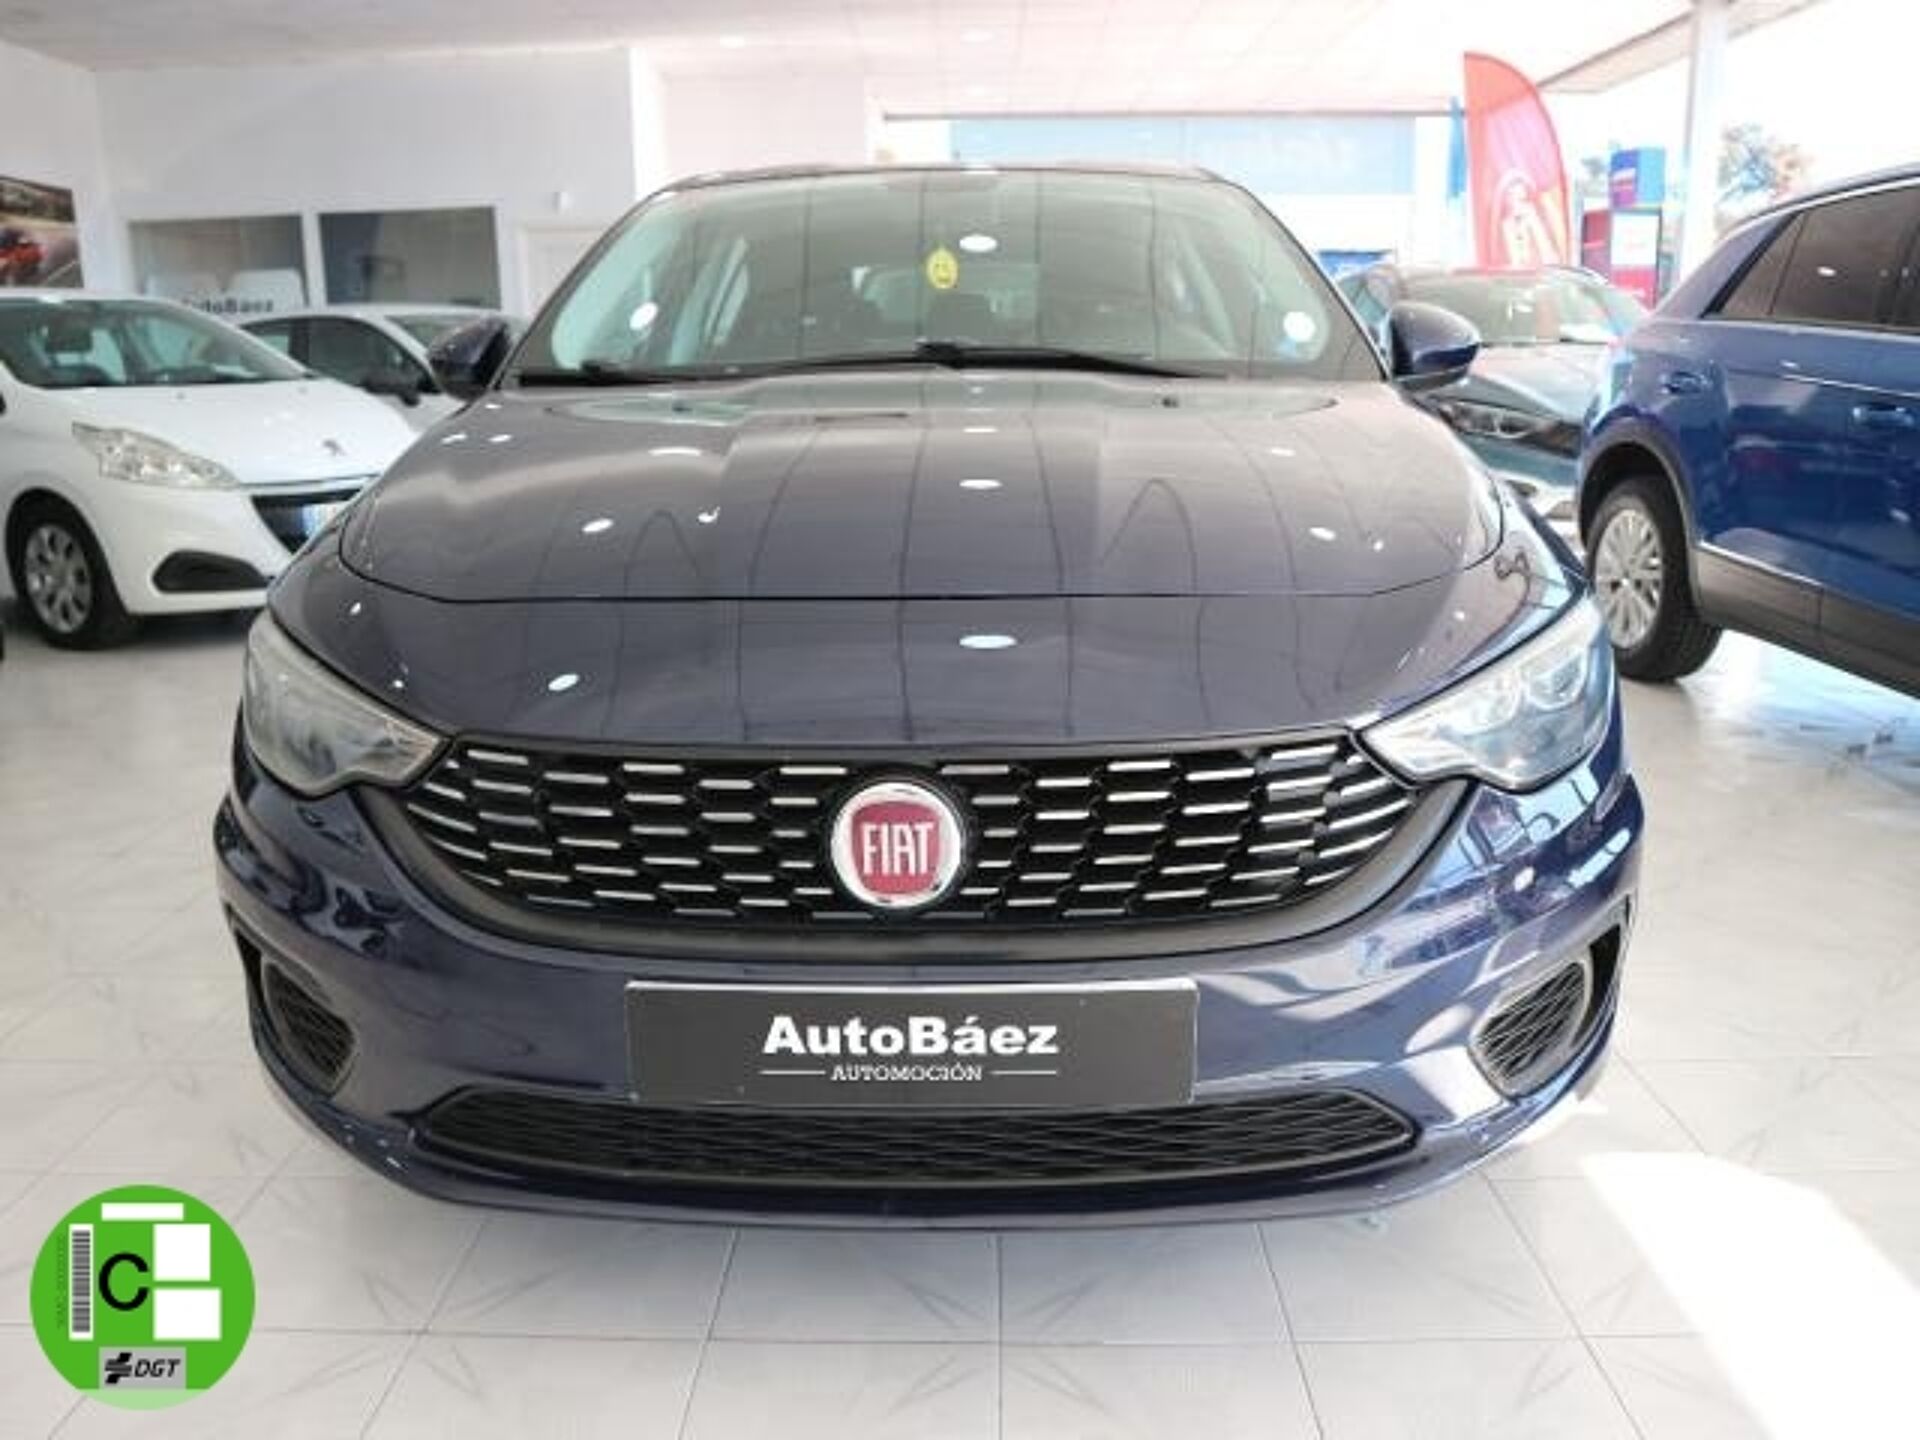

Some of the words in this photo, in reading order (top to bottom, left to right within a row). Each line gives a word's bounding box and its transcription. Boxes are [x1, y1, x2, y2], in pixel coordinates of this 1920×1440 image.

[862, 821, 933, 875] FIAT
[763, 1014, 1059, 1056] AutoBáez
[830, 1062, 984, 1082] AUTOMOCIÓN
